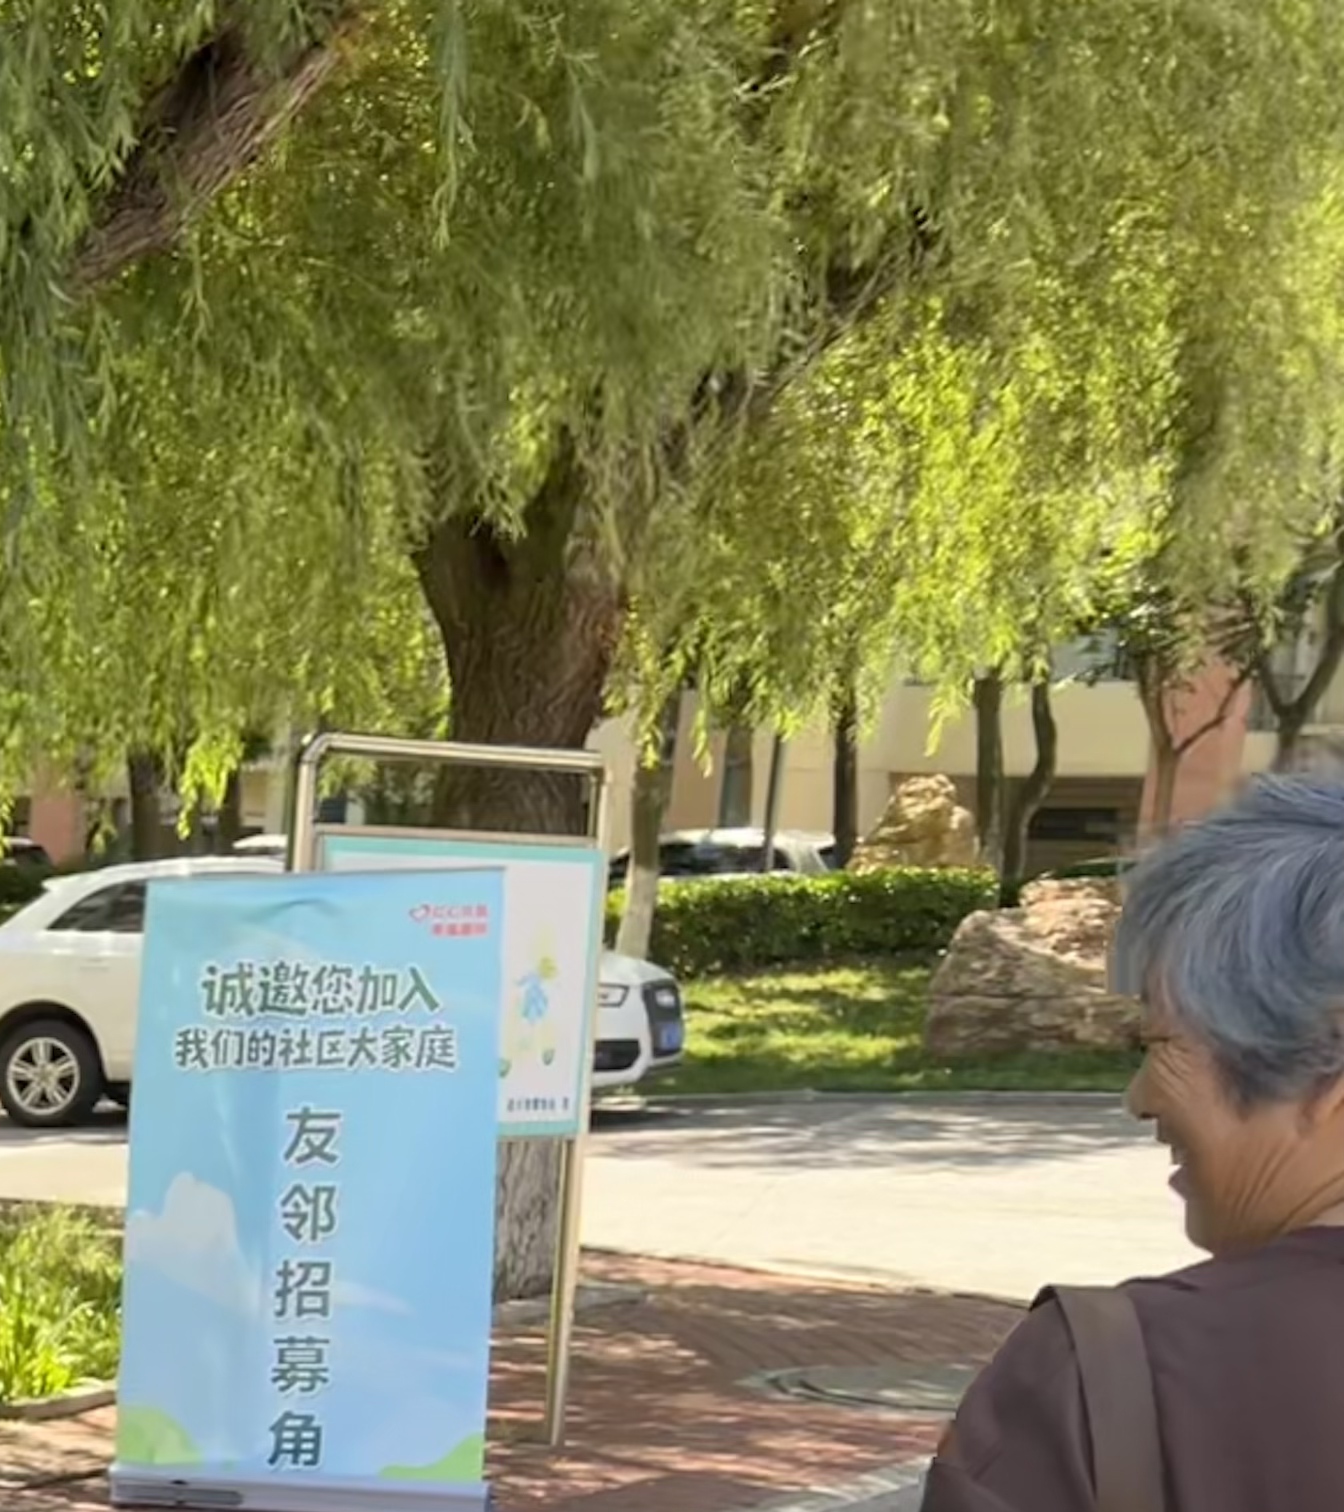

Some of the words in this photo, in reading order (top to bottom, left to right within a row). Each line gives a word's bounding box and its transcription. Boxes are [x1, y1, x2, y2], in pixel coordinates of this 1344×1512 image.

[201, 961, 442, 1019] 诚邀您加入
[175, 1027, 458, 1072] 我们的社区大家庭
[267, 1106, 343, 1473] 友邻招募角
